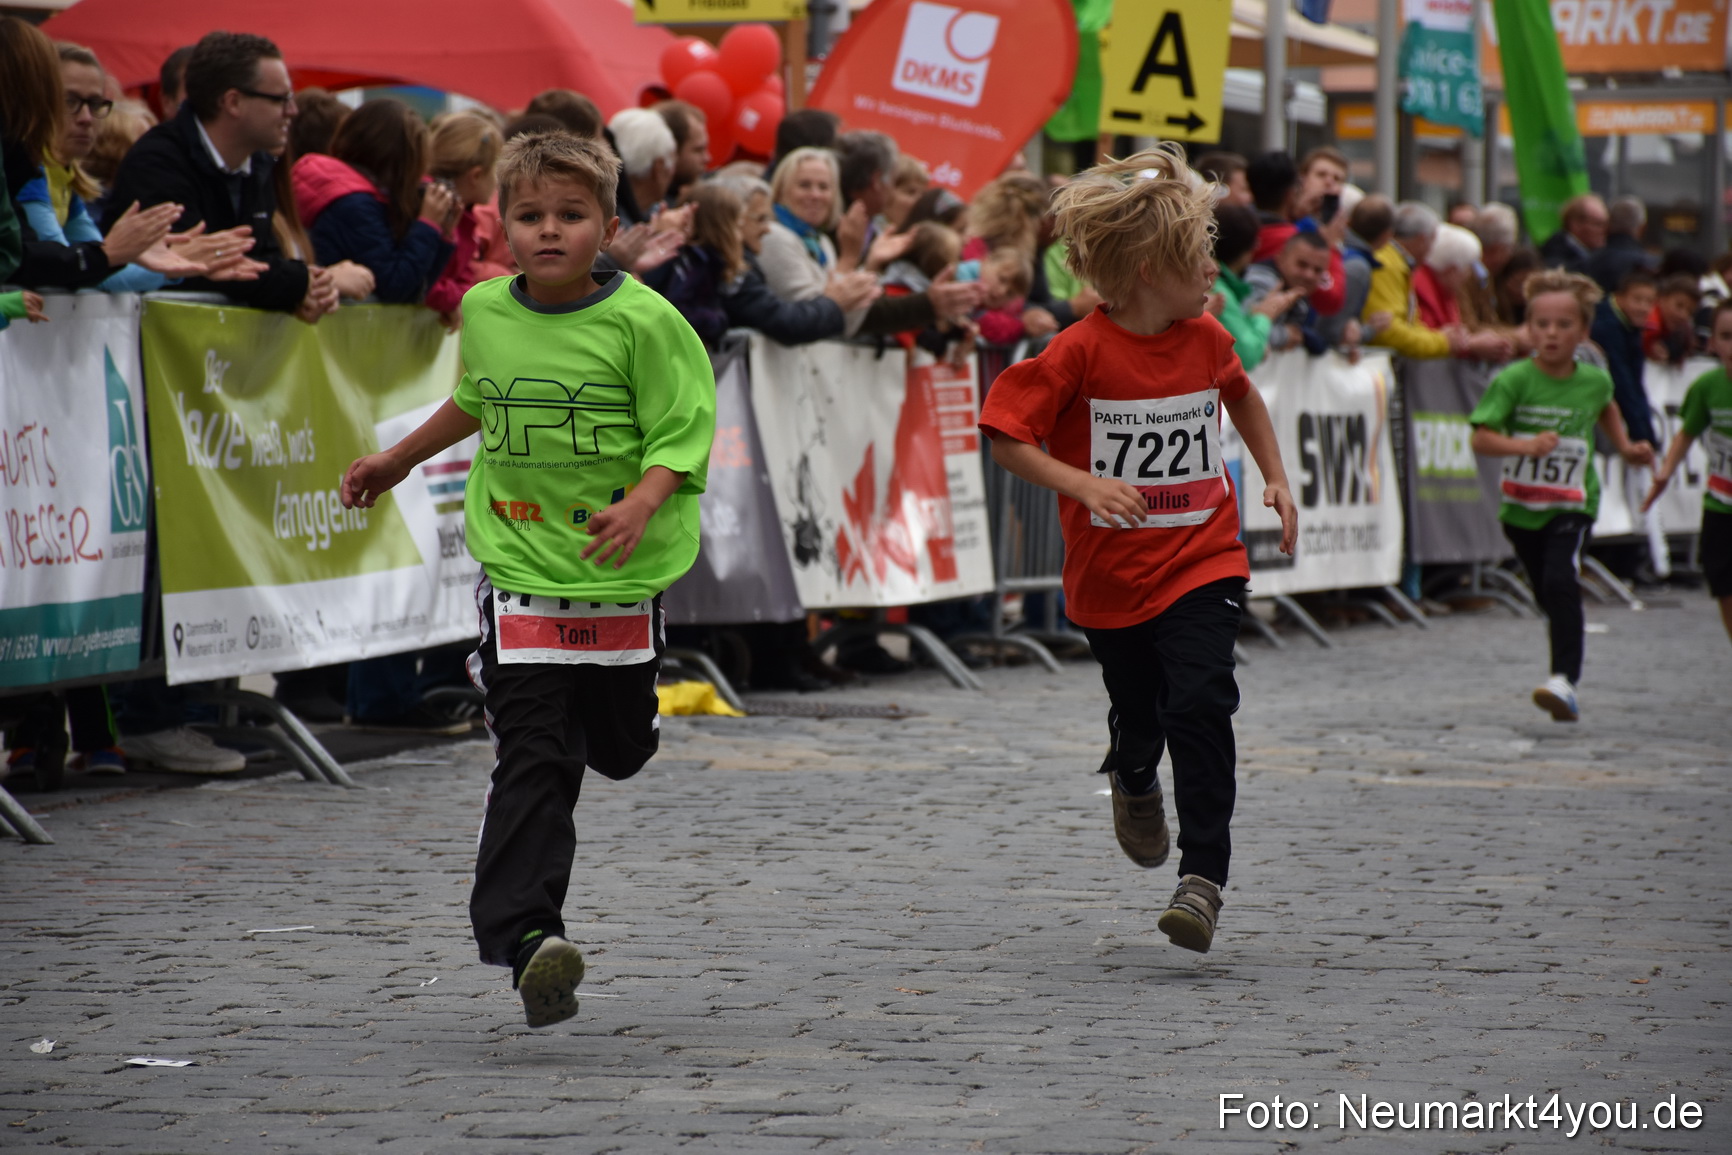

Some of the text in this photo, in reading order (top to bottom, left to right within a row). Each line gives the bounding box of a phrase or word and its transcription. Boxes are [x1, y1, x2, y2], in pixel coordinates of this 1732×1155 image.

[1130, 10, 1197, 98] A
[902, 58, 976, 96] DKMS
[854, 94, 875, 112] Wir
[878, 99, 936, 125] besiegen
[1094, 406, 1202, 425] PARTL Neumarkt
[499, 458, 511, 468] und
[512, 455, 614, 470] Automatisierungstechnik
[1106, 424, 1210, 478] 7221
[555, 624, 597, 645] Toni
